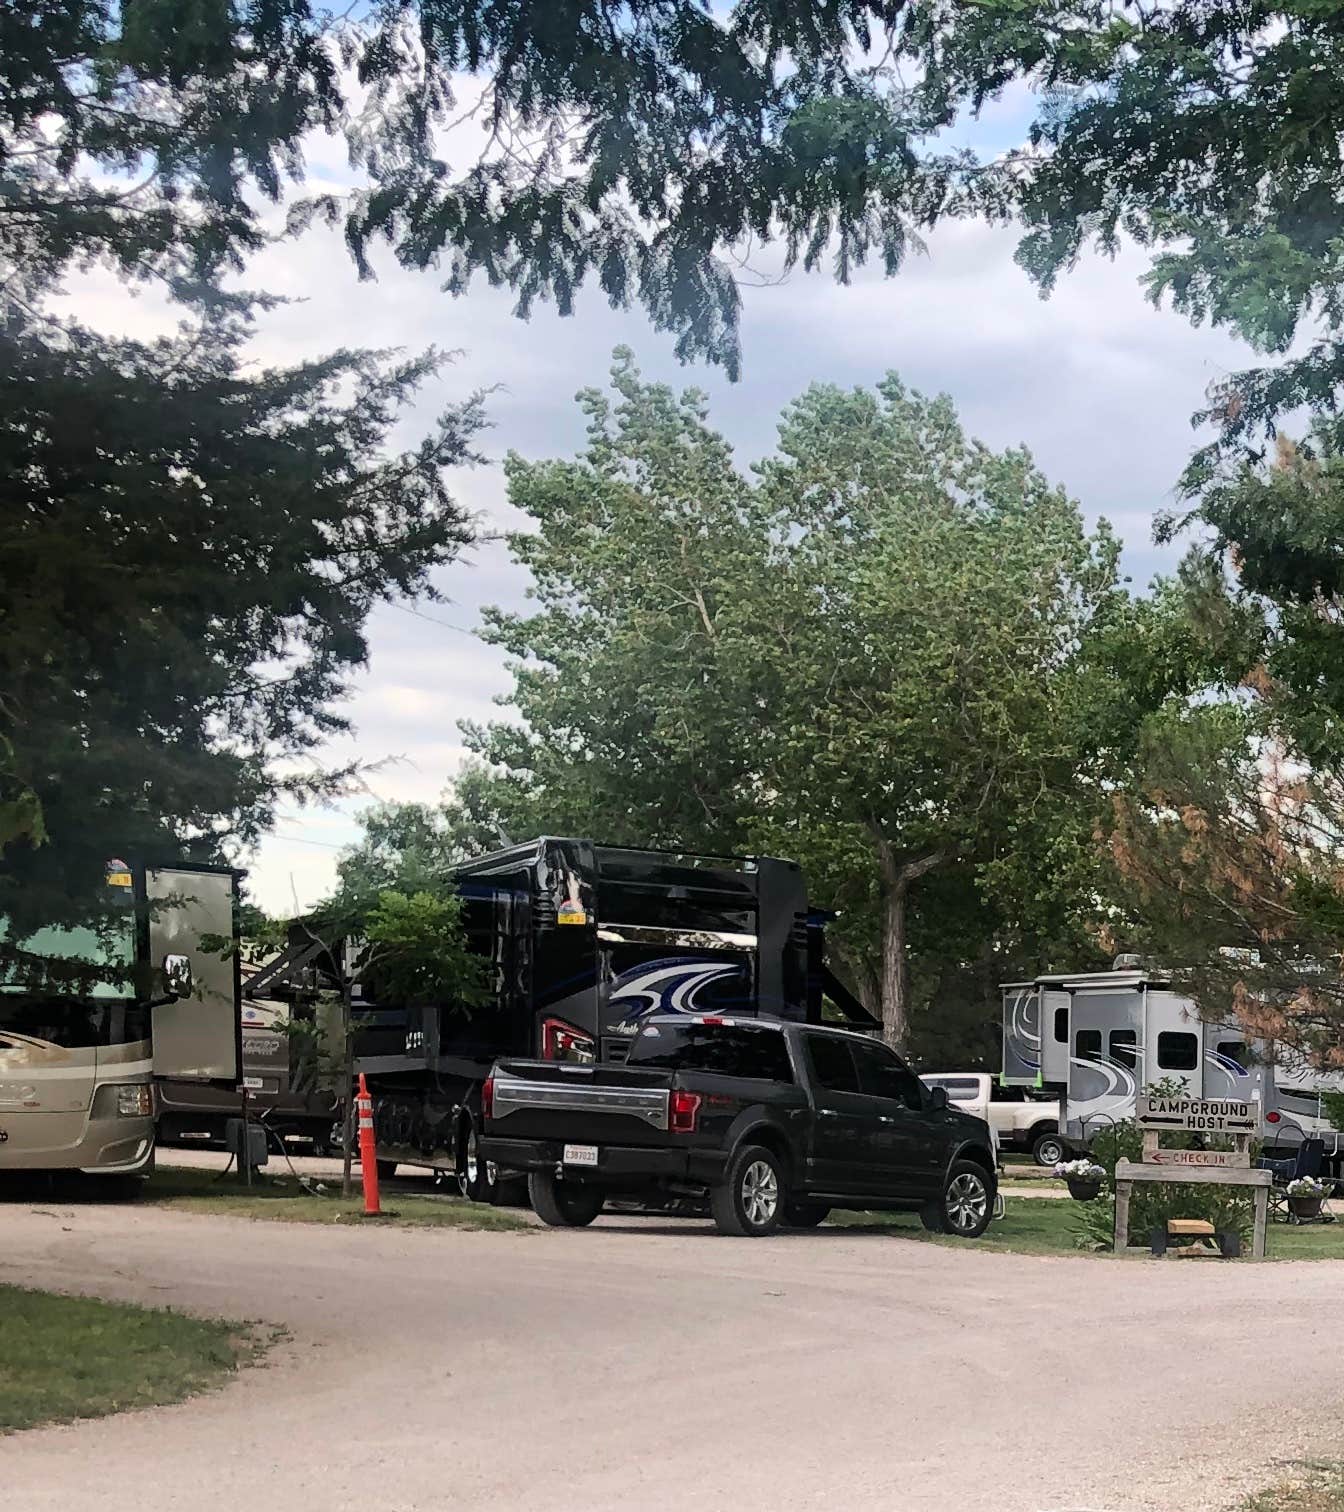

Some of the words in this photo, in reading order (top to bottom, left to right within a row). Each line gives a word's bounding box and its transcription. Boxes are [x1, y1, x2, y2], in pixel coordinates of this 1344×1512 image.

[1148, 1100, 1248, 1117] CAMPGROUND
[1187, 1116, 1225, 1130] HOST
[1173, 1153, 1208, 1164] CHECK
[1214, 1155, 1225, 1164] IN
